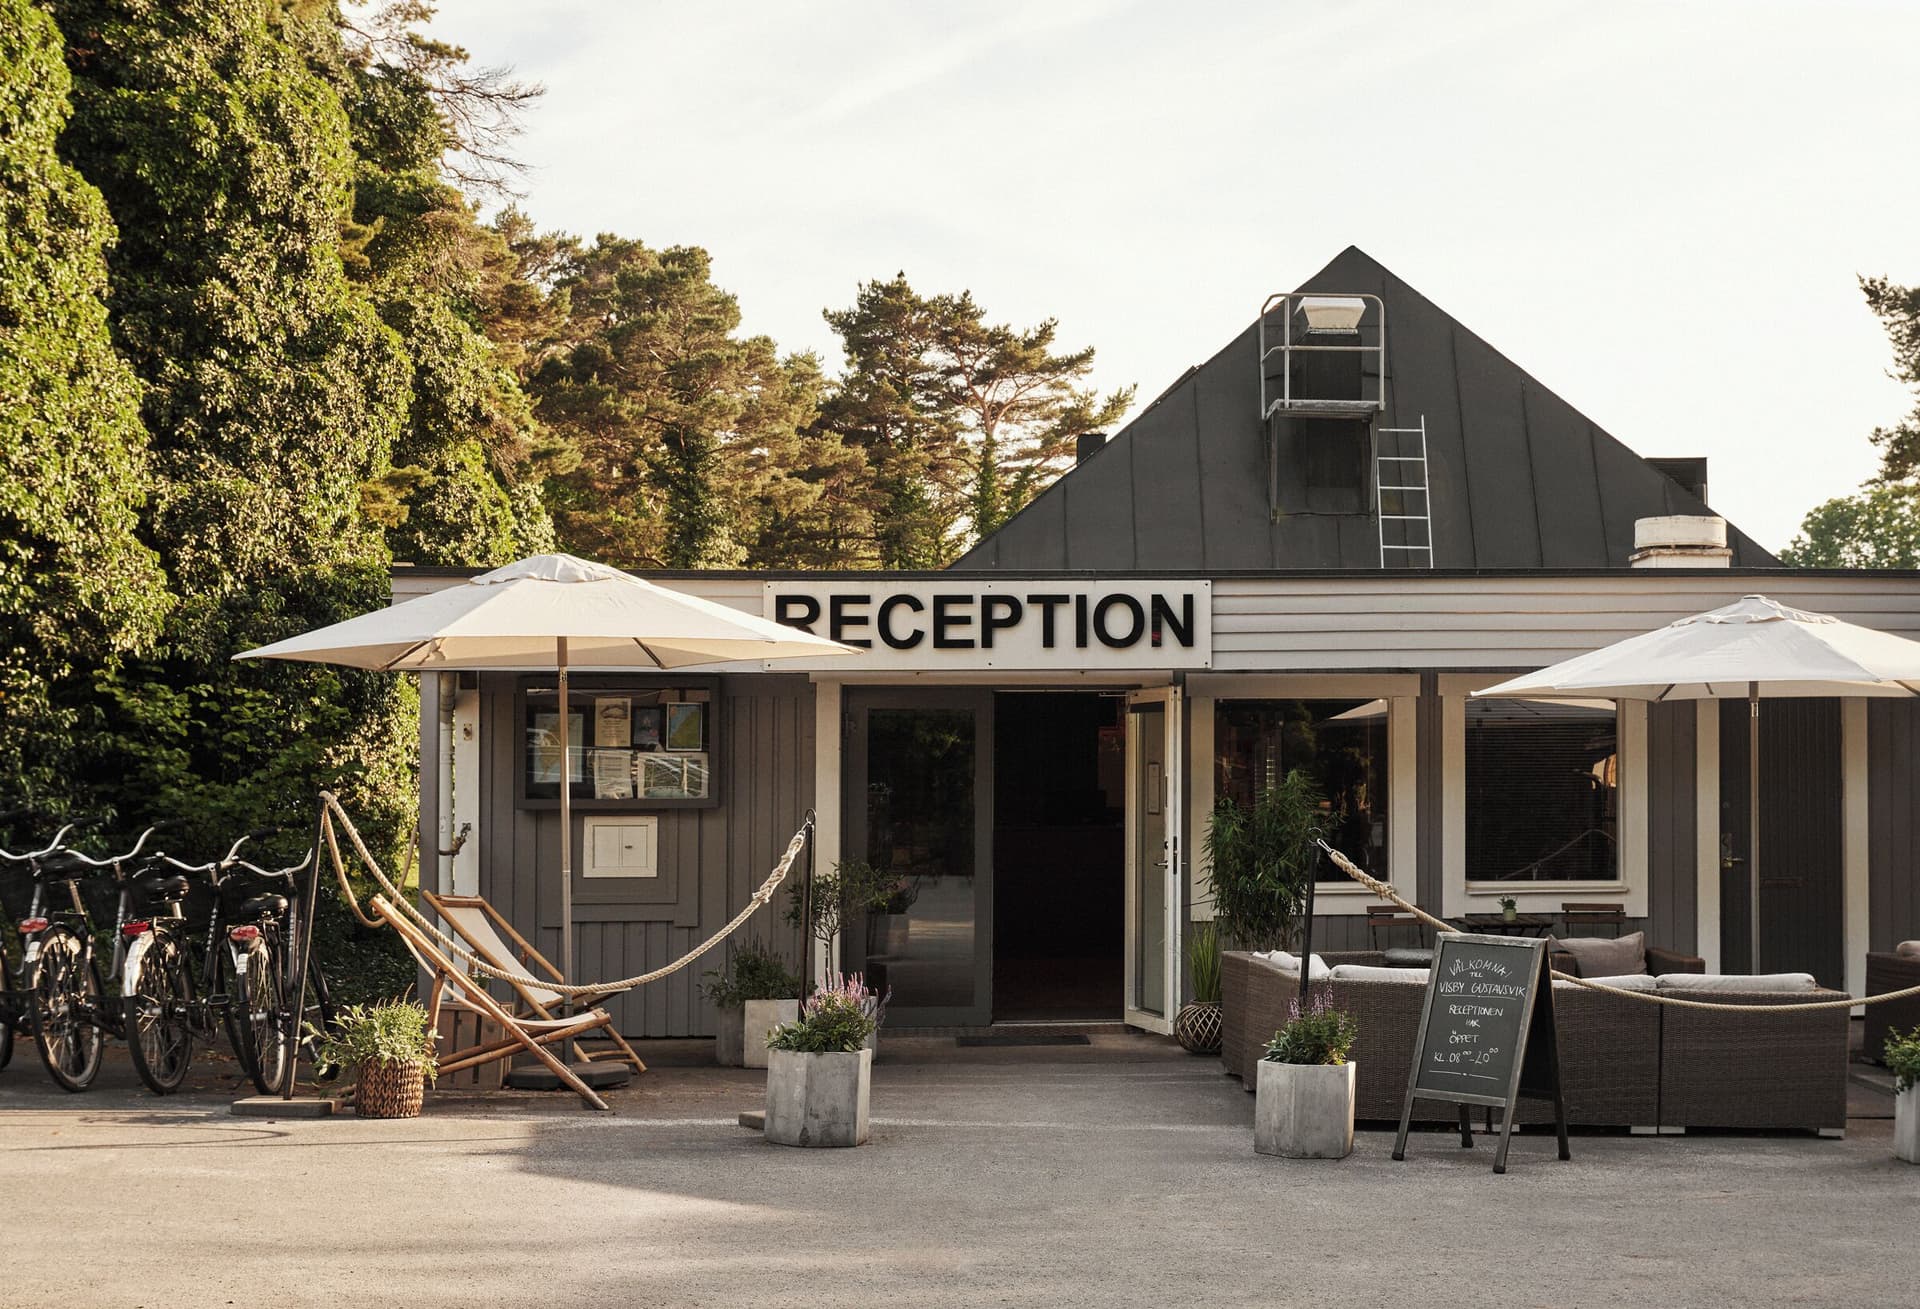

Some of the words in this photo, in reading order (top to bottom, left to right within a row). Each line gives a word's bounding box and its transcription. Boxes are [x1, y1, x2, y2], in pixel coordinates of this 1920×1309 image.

[774, 593, 1195, 650] RECEPTION
[1440, 981, 1465, 993] VISBY
[1471, 982, 1526, 997] GUSTAVSVIK
[1448, 1029, 1480, 1045] ÖPPET
